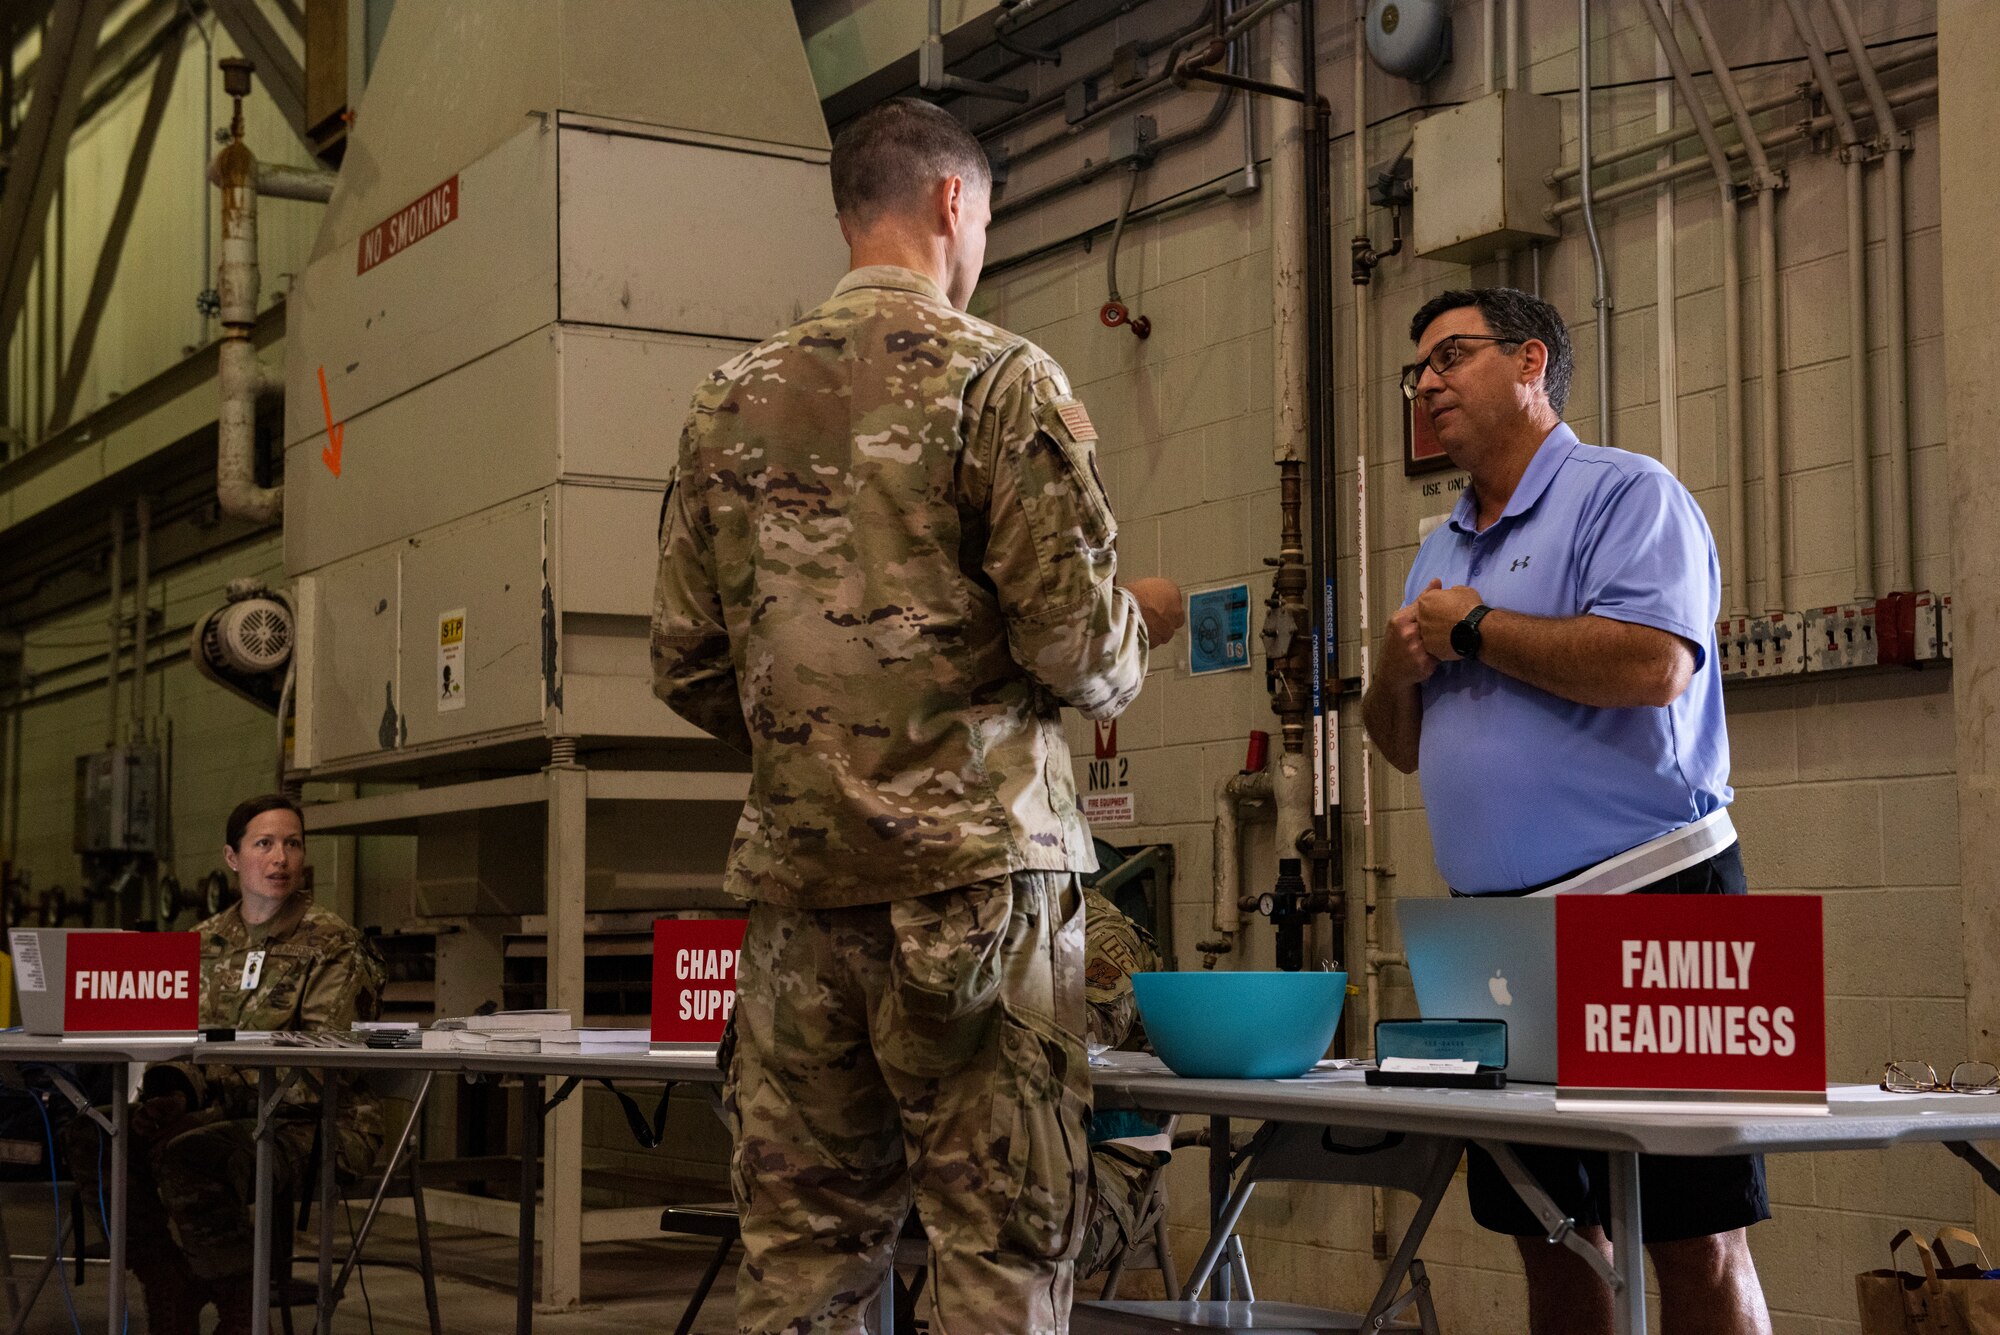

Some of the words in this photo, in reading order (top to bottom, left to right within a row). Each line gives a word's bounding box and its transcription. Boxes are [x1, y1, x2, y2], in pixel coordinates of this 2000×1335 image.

[364, 227, 383, 269] NO
[388, 184, 451, 254] SMOKING
[1422, 481, 1442, 497] USE
[1328, 765, 1336, 798] PSI
[1621, 940, 1756, 990] FAMILY
[74, 970, 189, 1000] FINANCE
[678, 989, 736, 1021] SUPP
[1584, 1003, 1797, 1057] READINESS
